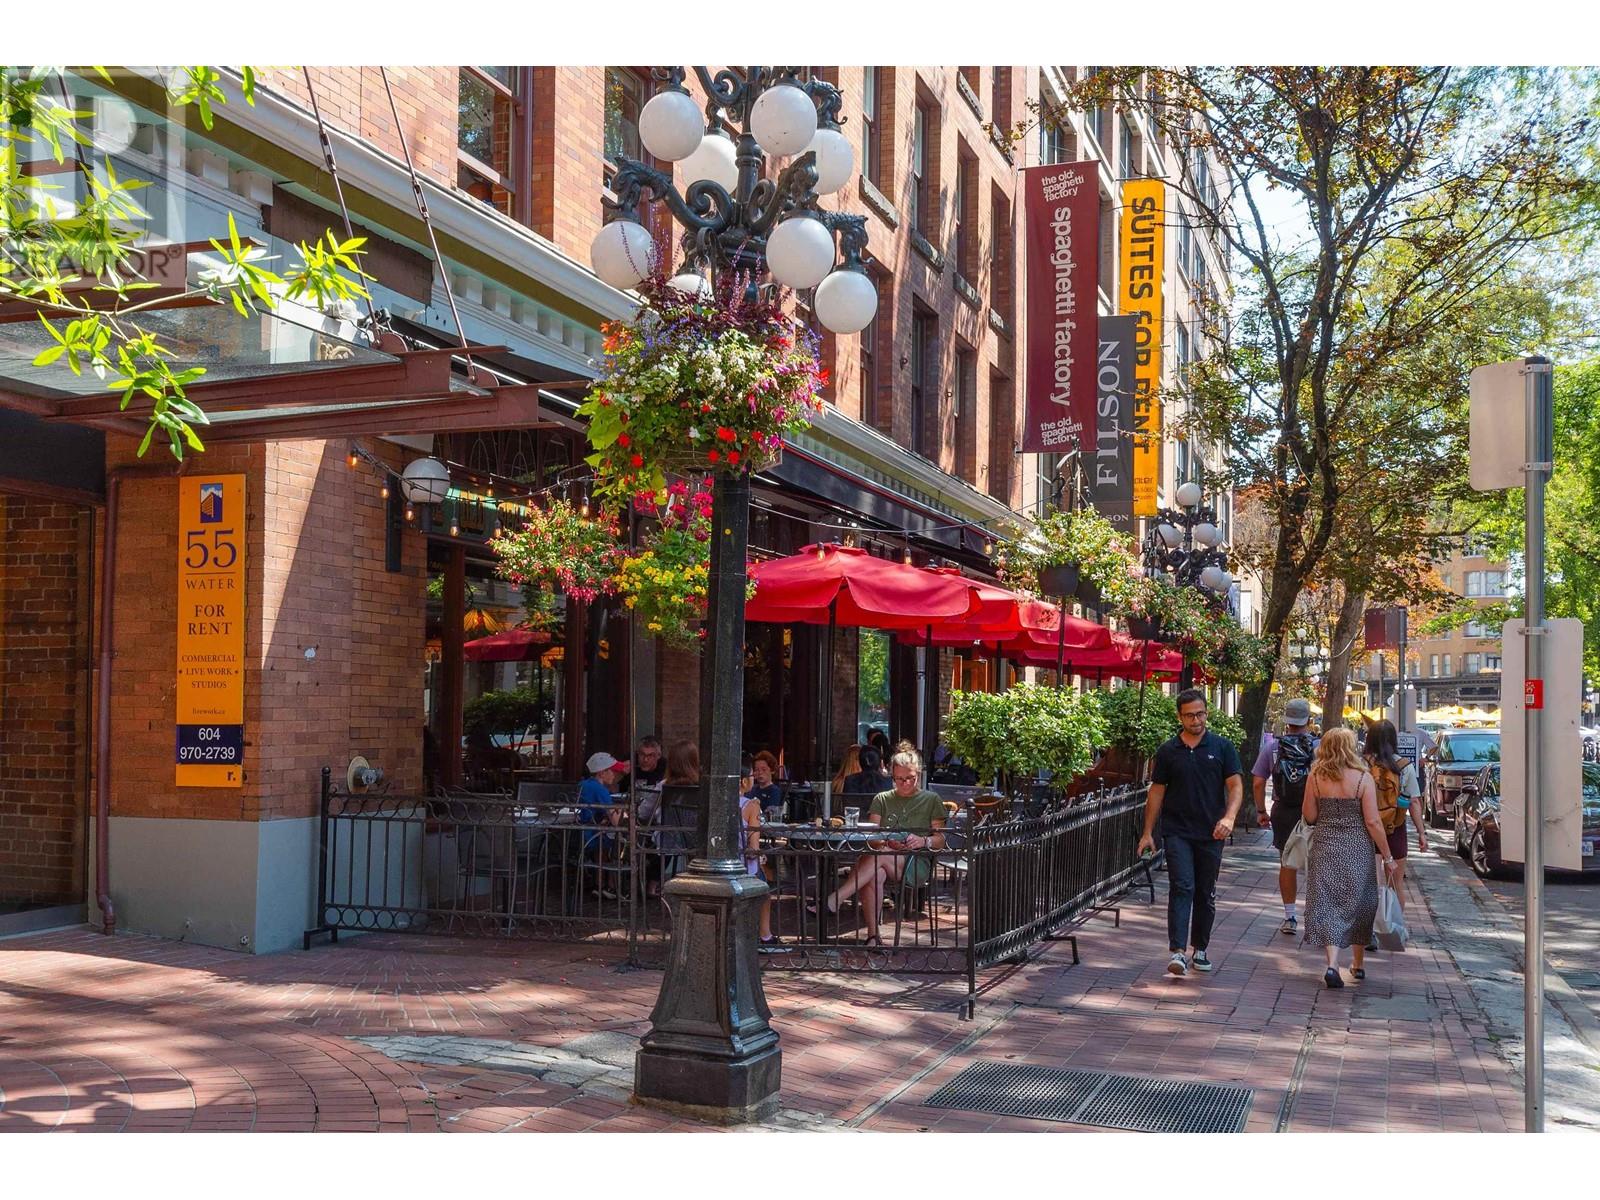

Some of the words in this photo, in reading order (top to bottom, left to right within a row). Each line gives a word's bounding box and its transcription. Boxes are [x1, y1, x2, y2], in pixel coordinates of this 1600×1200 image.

[1042, 175, 1058, 187] the
[1058, 169, 1075, 182] old
[1043, 174, 1084, 195] spaghetti
[1045, 186, 1079, 202] factory
[1129, 196, 1156, 300] SUITES
[1050, 206, 1077, 316] spaghetti
[1050, 318, 1077, 406] factory
[1096, 338, 1121, 488] FILSON
[1040, 421, 1056, 432] the
[1057, 415, 1072, 428] old
[1041, 421, 1083, 439] spaghetti
[185, 528, 237, 569] 55
[186, 578, 235, 590] WATER
[194, 604, 226, 618] FOR
[188, 622, 233, 636] RENT
[182, 654, 237, 663] COMMERCIAL
[186, 667, 206, 676] LIVE
[207, 667, 233, 676] WORK
[191, 681, 227, 689] STUDIOS
[198, 727, 221, 741] 604
[179, 746, 236, 760] 970-2739
